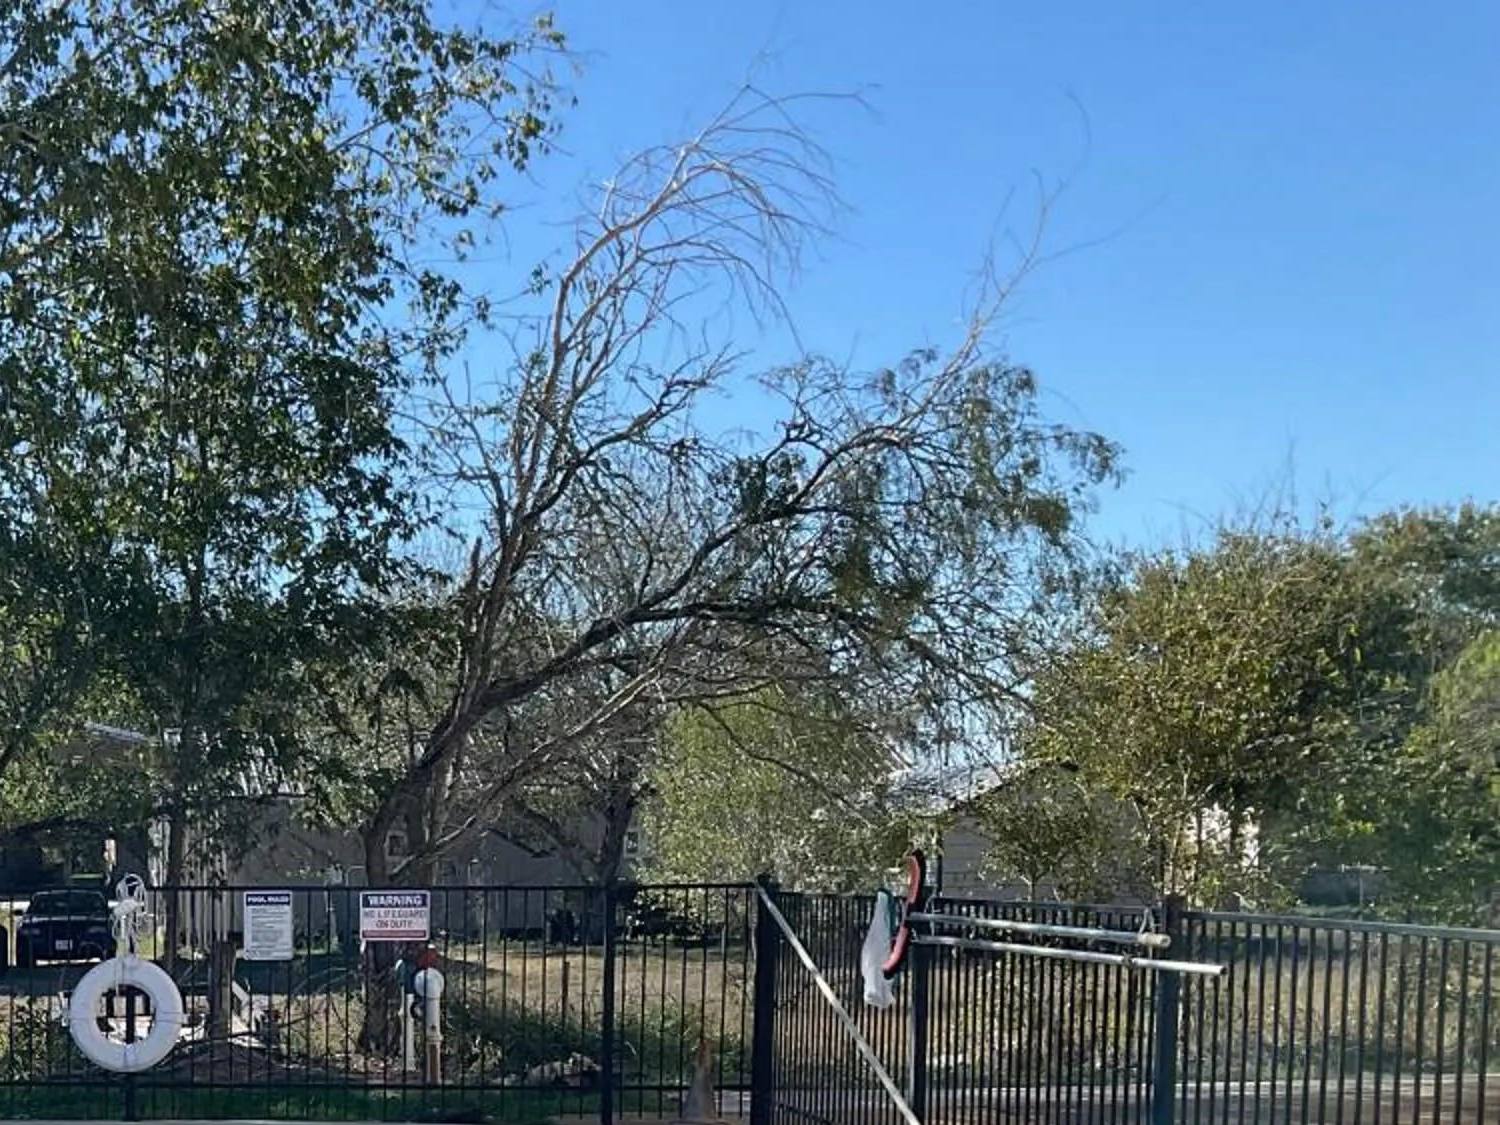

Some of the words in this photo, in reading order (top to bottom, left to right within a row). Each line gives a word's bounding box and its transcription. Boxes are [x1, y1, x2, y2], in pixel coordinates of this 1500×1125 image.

[367, 895, 422, 906] WARNING
[375, 919, 389, 928] ON
[390, 919, 412, 928] DUTY
